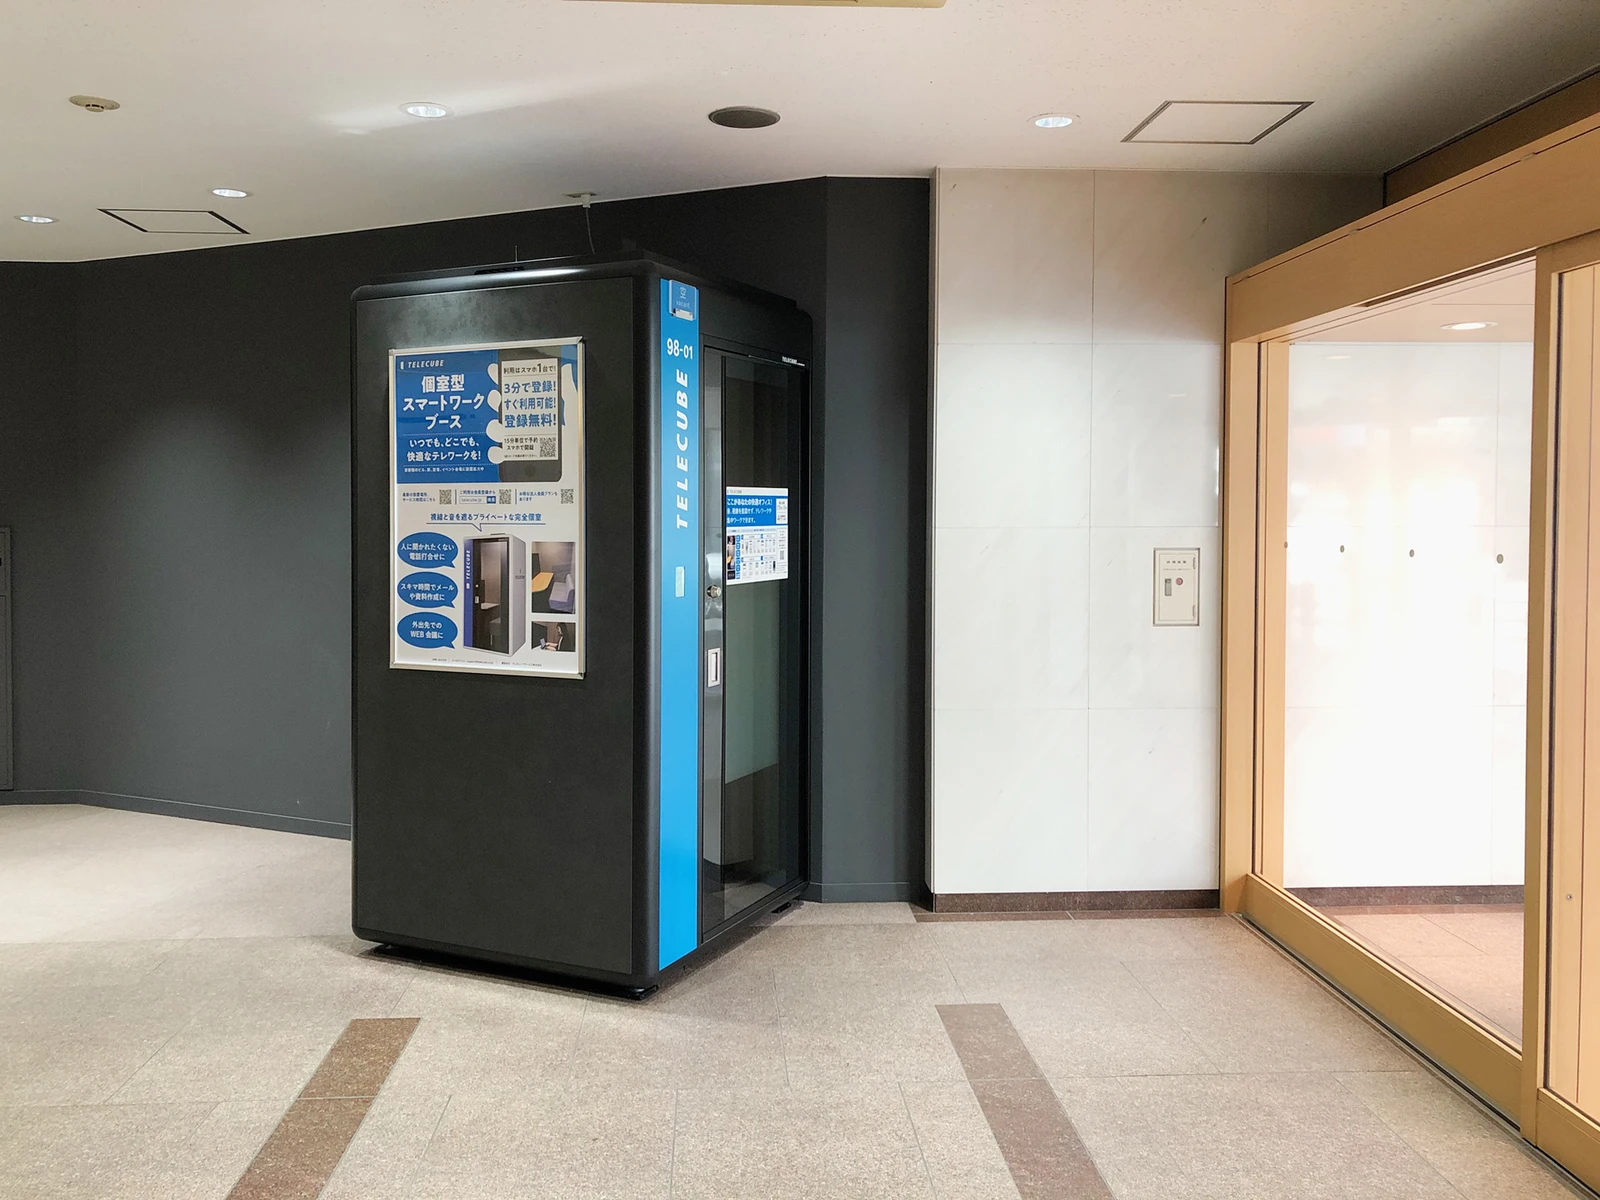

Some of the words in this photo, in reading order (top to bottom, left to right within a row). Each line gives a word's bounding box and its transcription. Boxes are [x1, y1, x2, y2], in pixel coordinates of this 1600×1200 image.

[666, 338, 693, 360] 98-01
[407, 360, 445, 368] TELECUBE
[421, 374, 465, 393] 個室型
[402, 393, 485, 412] スマートワーク
[425, 413, 462, 430] ブース
[409, 437, 480, 448] いつでも、どこでも、
[676, 369, 689, 529] TELECUBE
[400, 543, 455, 551] 人に聞かれたくない
[400, 583, 455, 591] スキマ時間でメール
[412, 621, 443, 629] 外出先での
